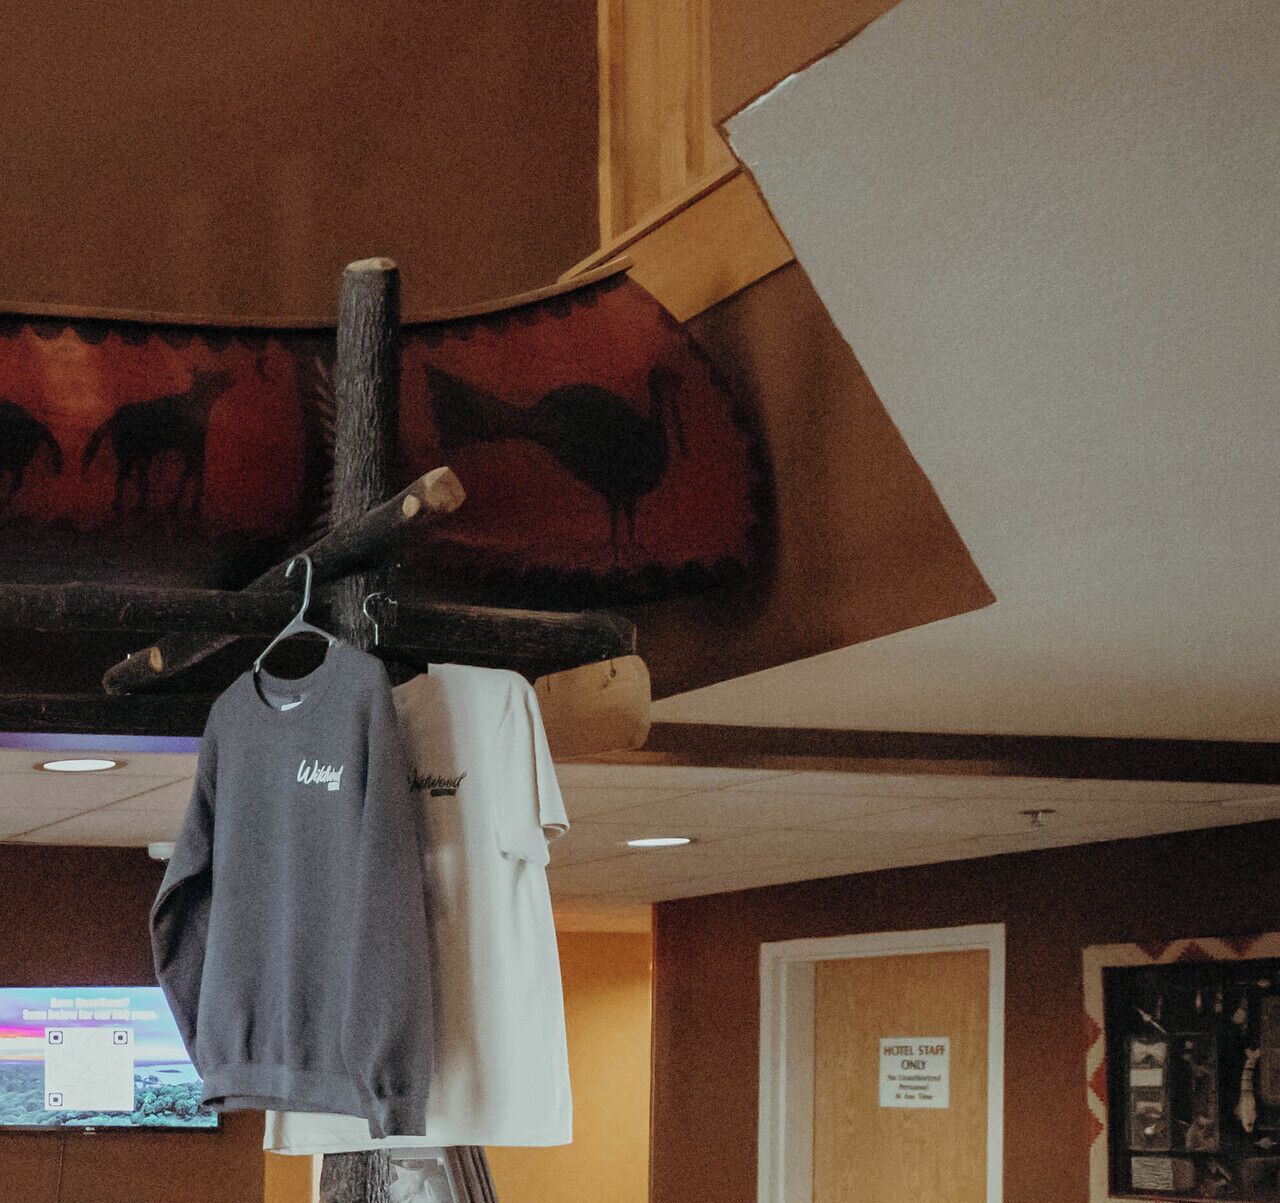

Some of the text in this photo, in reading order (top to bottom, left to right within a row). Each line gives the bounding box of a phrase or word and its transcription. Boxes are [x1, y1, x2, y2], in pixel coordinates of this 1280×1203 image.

[883, 1045, 945, 1056] HOTEL STAFF
[901, 1060, 927, 1070] ONLY
